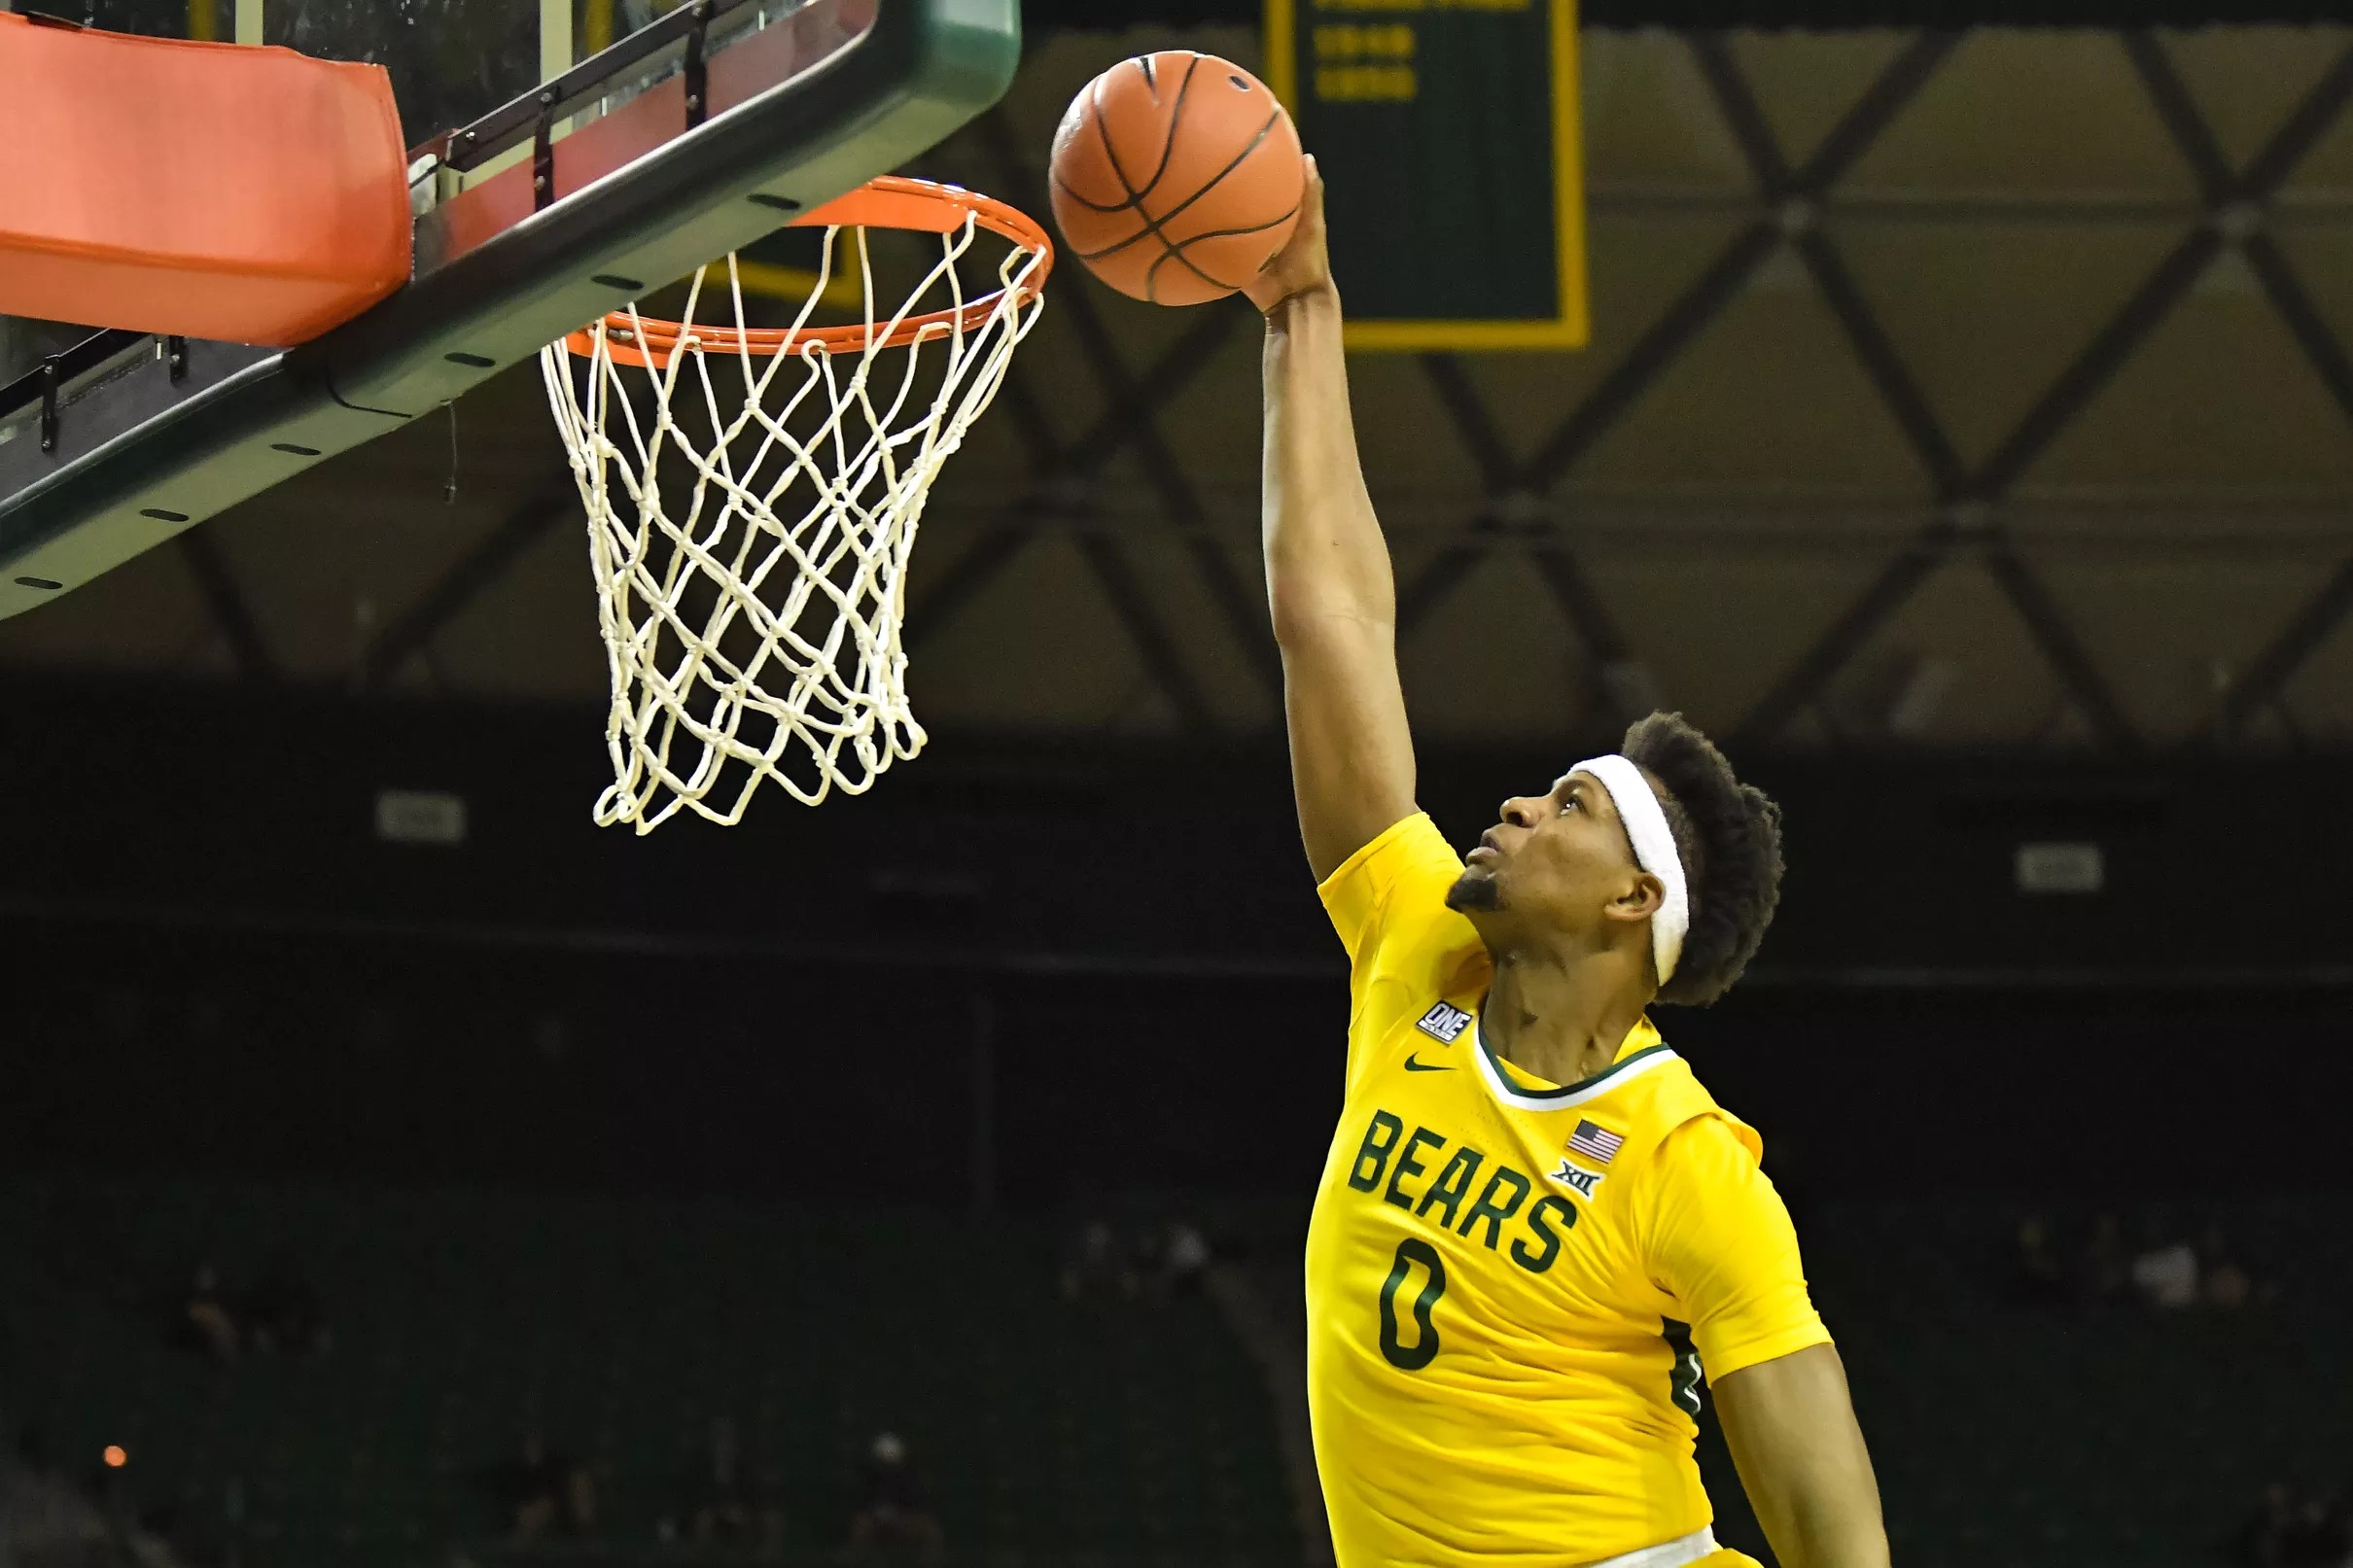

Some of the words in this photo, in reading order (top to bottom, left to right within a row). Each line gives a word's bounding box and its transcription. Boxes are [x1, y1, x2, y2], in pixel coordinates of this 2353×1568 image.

[1424, 1002, 1471, 1036] ONE
[1348, 1109, 1577, 1273] BEARS
[1551, 1161, 1600, 1197] XII
[1379, 1237, 1447, 1372] 0
